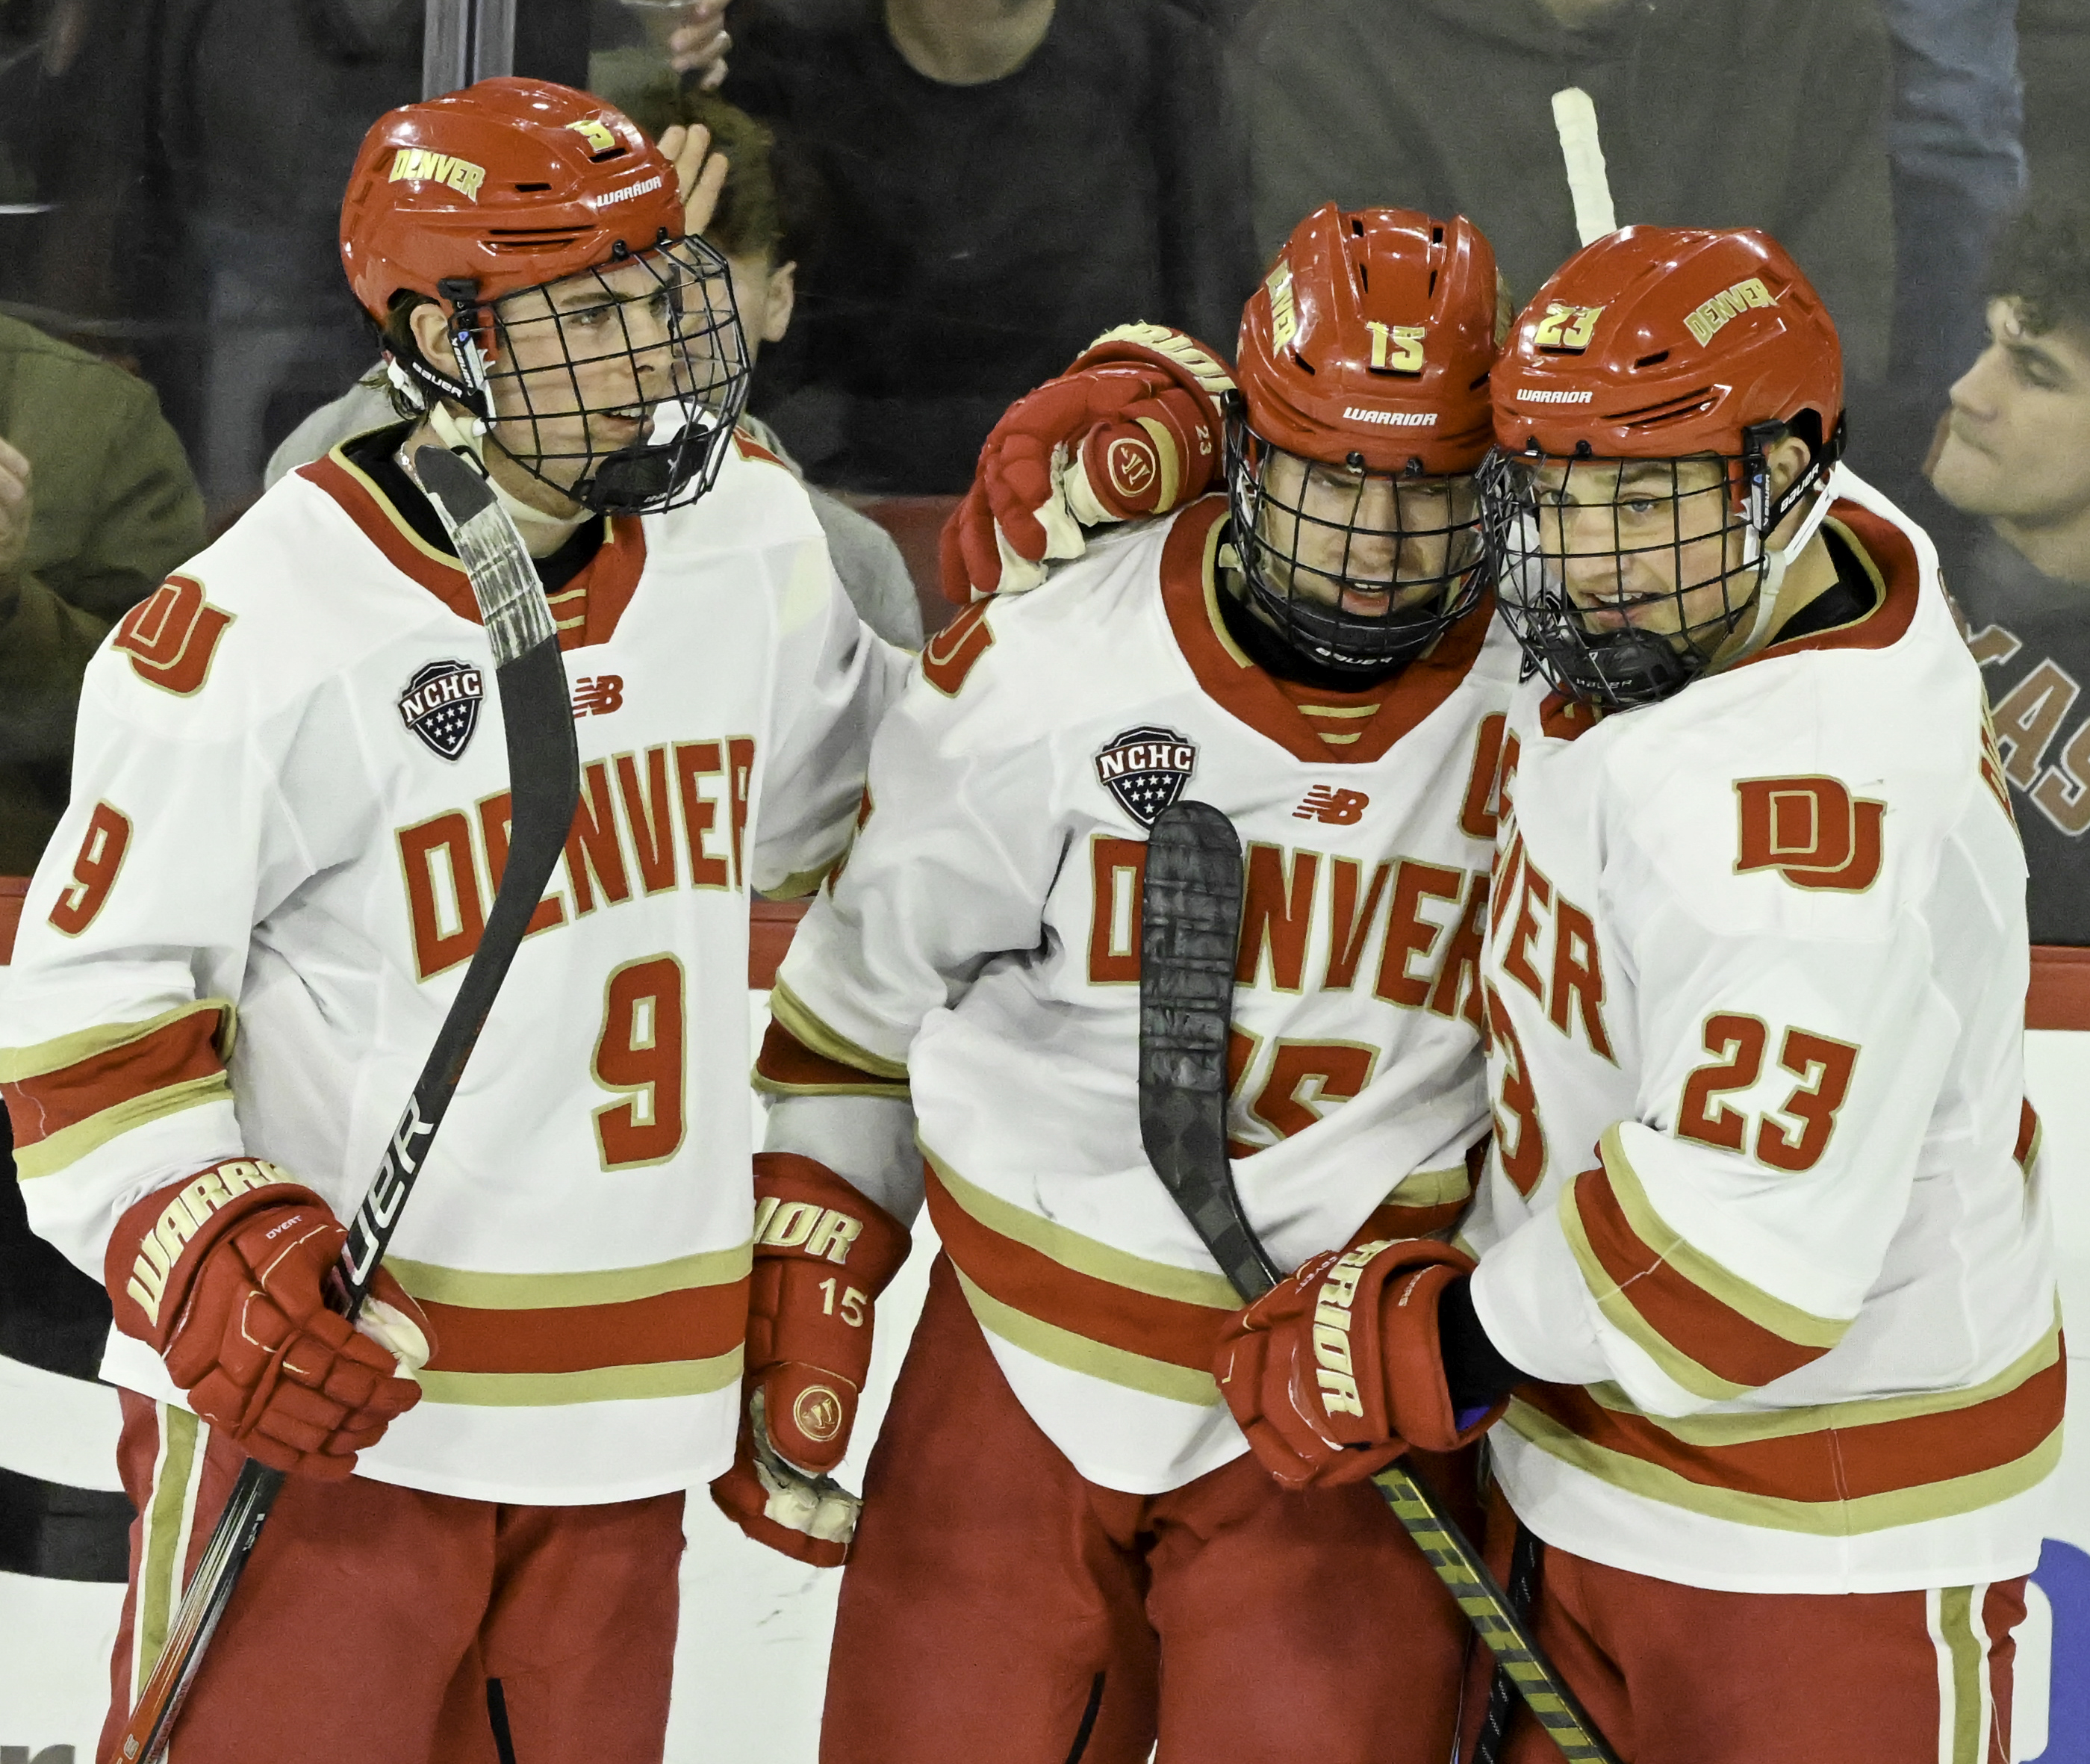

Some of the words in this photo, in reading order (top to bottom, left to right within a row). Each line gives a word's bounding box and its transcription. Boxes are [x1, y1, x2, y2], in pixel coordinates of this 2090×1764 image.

[389, 149, 485, 202] DENVER
[597, 176, 662, 207] WARRIOR
[1534, 303, 1606, 350] 23
[1683, 277, 1779, 348] DENVER
[1366, 321, 1428, 371] 15
[412, 361, 463, 398] BAUER
[1516, 388, 1593, 403] WARRIOR
[1195, 425, 1212, 456] 23
[1343, 406, 1438, 426] WARRIOR
[1780, 462, 1820, 514] BAUER
[401, 671, 482, 724] NCHC
[1101, 745, 1192, 780] NCHC
[47, 798, 134, 940] 9
[1086, 833, 1487, 1037] DNVER
[590, 950, 688, 1173] 9
[1673, 1010, 1862, 1174] 23
[818, 1276, 868, 1329] 15
